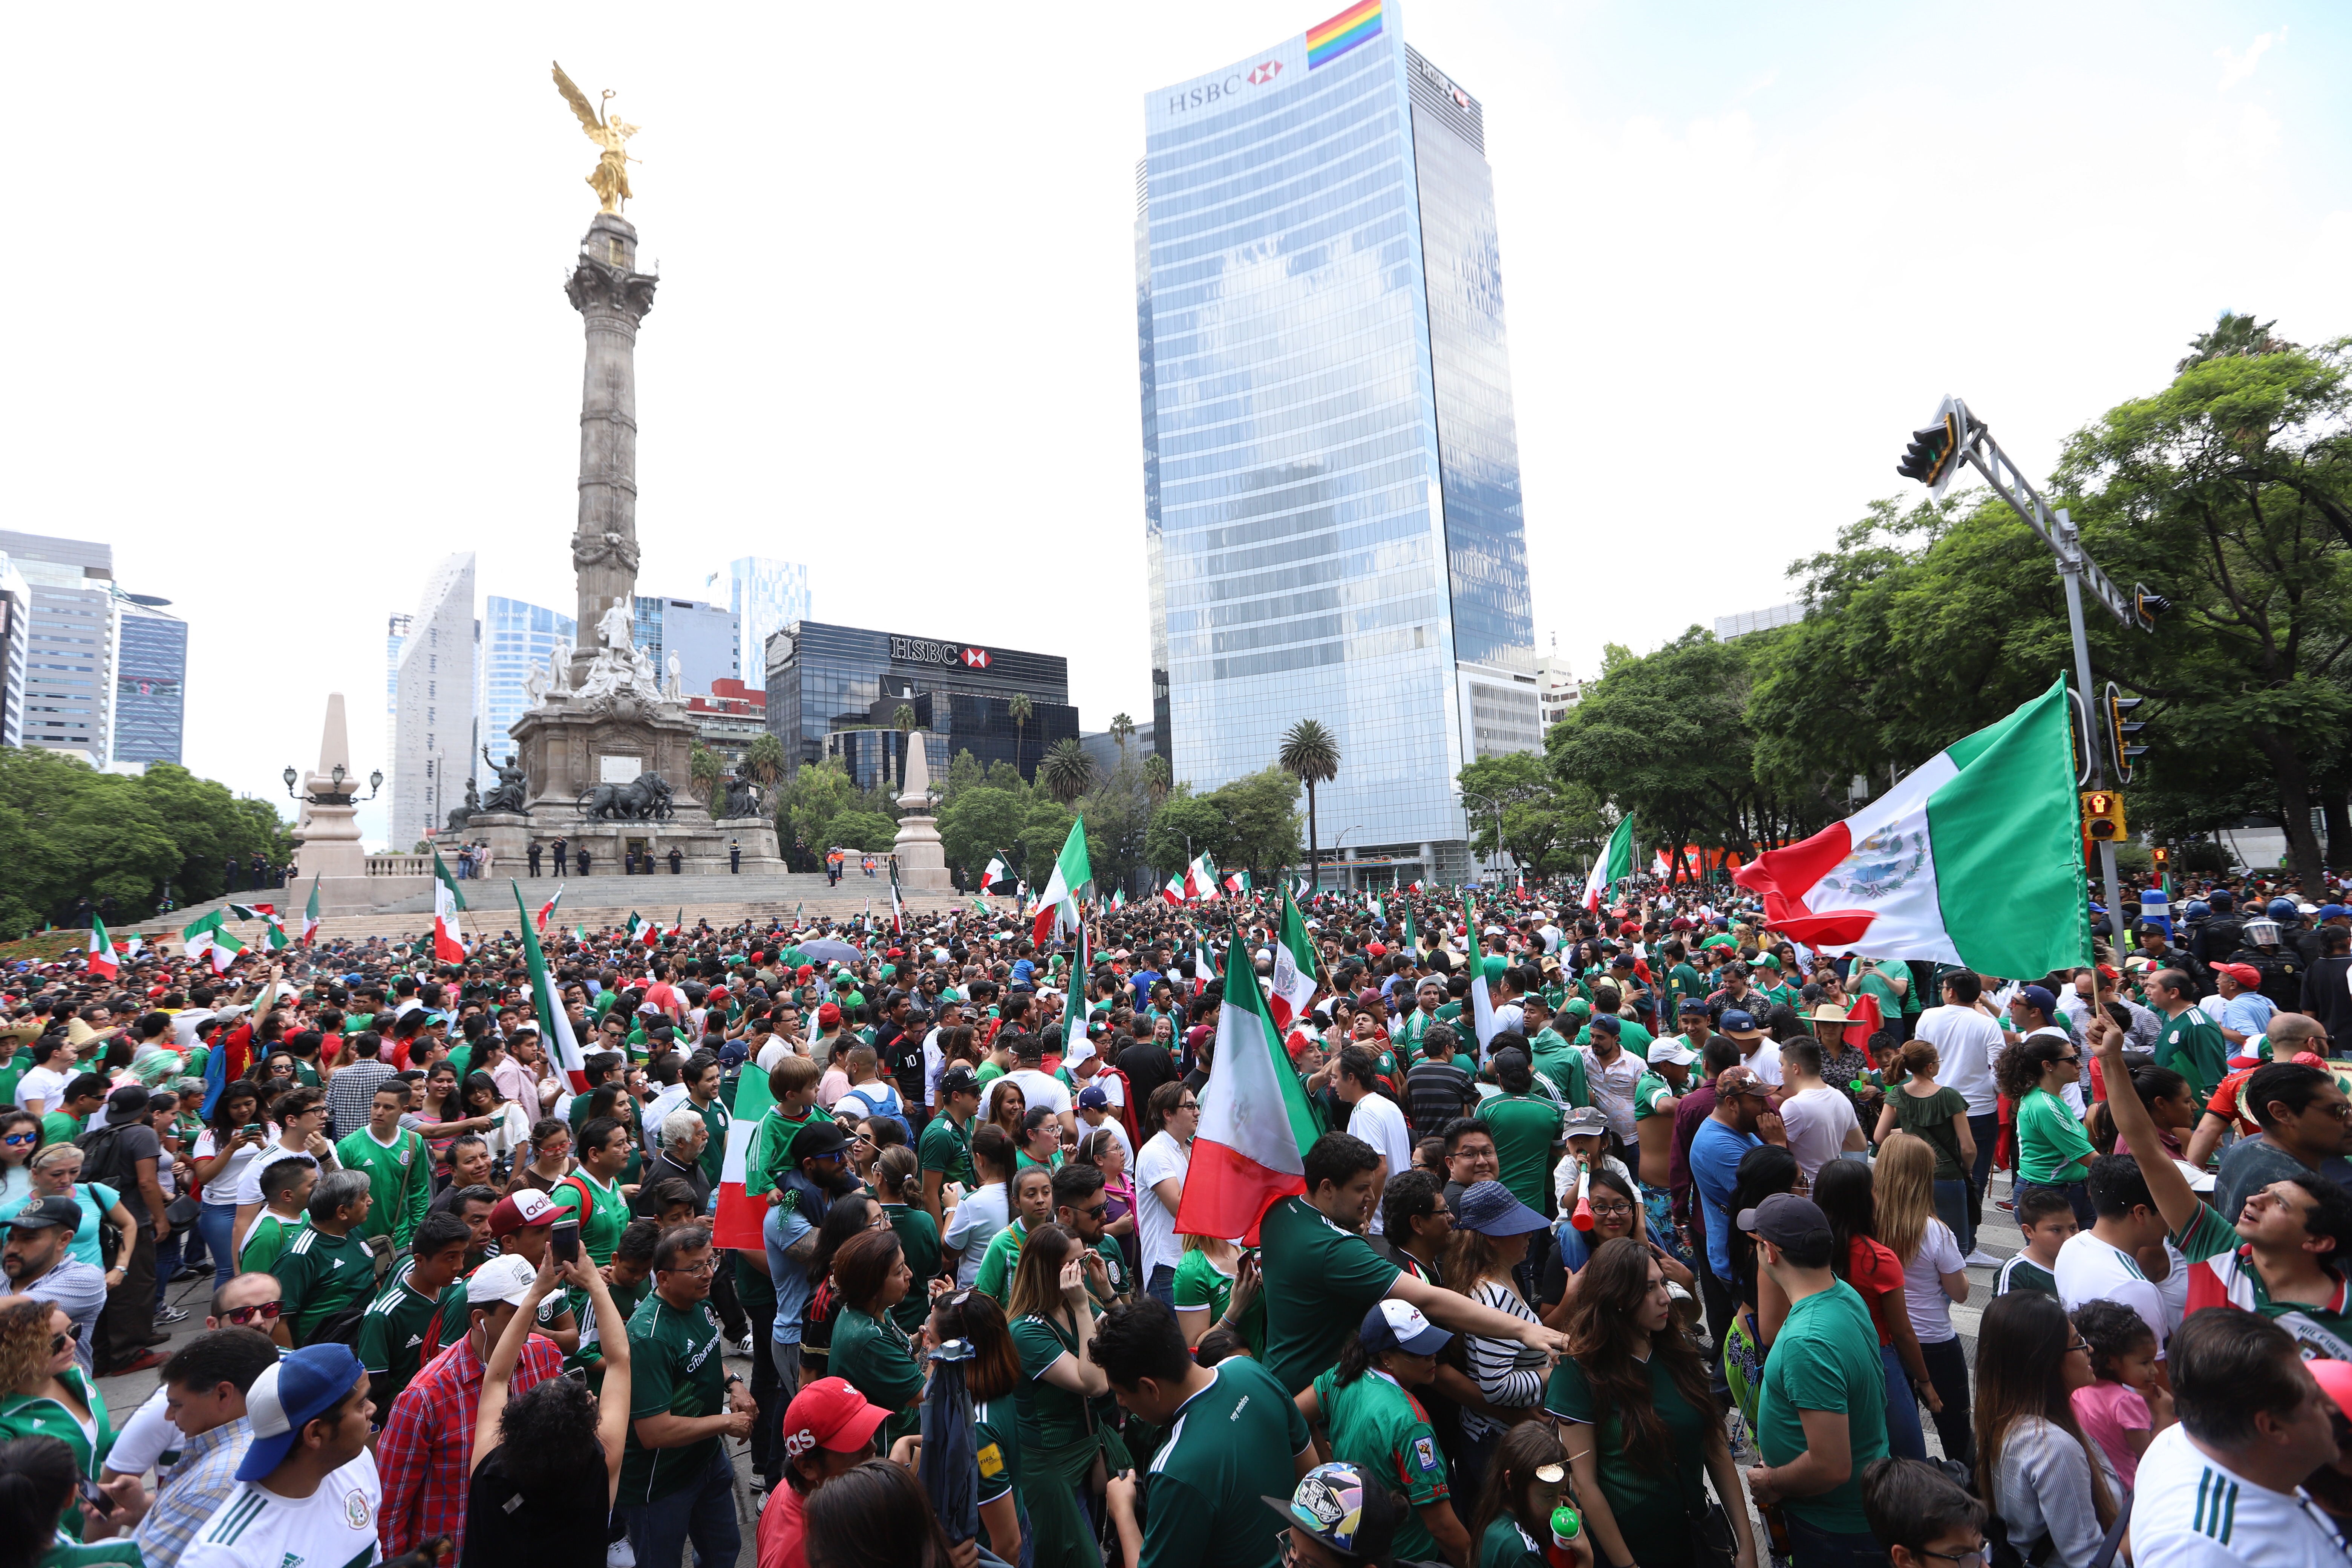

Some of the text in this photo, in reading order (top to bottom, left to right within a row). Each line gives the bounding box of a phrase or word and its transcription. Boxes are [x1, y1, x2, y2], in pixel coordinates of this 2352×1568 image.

[1421, 63, 1454, 97] HSBC
[1169, 75, 1241, 115] HSBC
[891, 637, 958, 665] HSBC
[905, 1054, 917, 1068] 10
[405, 1339, 423, 1348] adidas
[1230, 1395, 1249, 1421] soy méxico
[784, 1428, 816, 1457] as
[980, 1456, 993, 1465] FIFA
[1309, 1480, 1325, 1498] VANS
[1307, 1490, 1320, 1507] THE
[1316, 1498, 1339, 1514] WALL"
